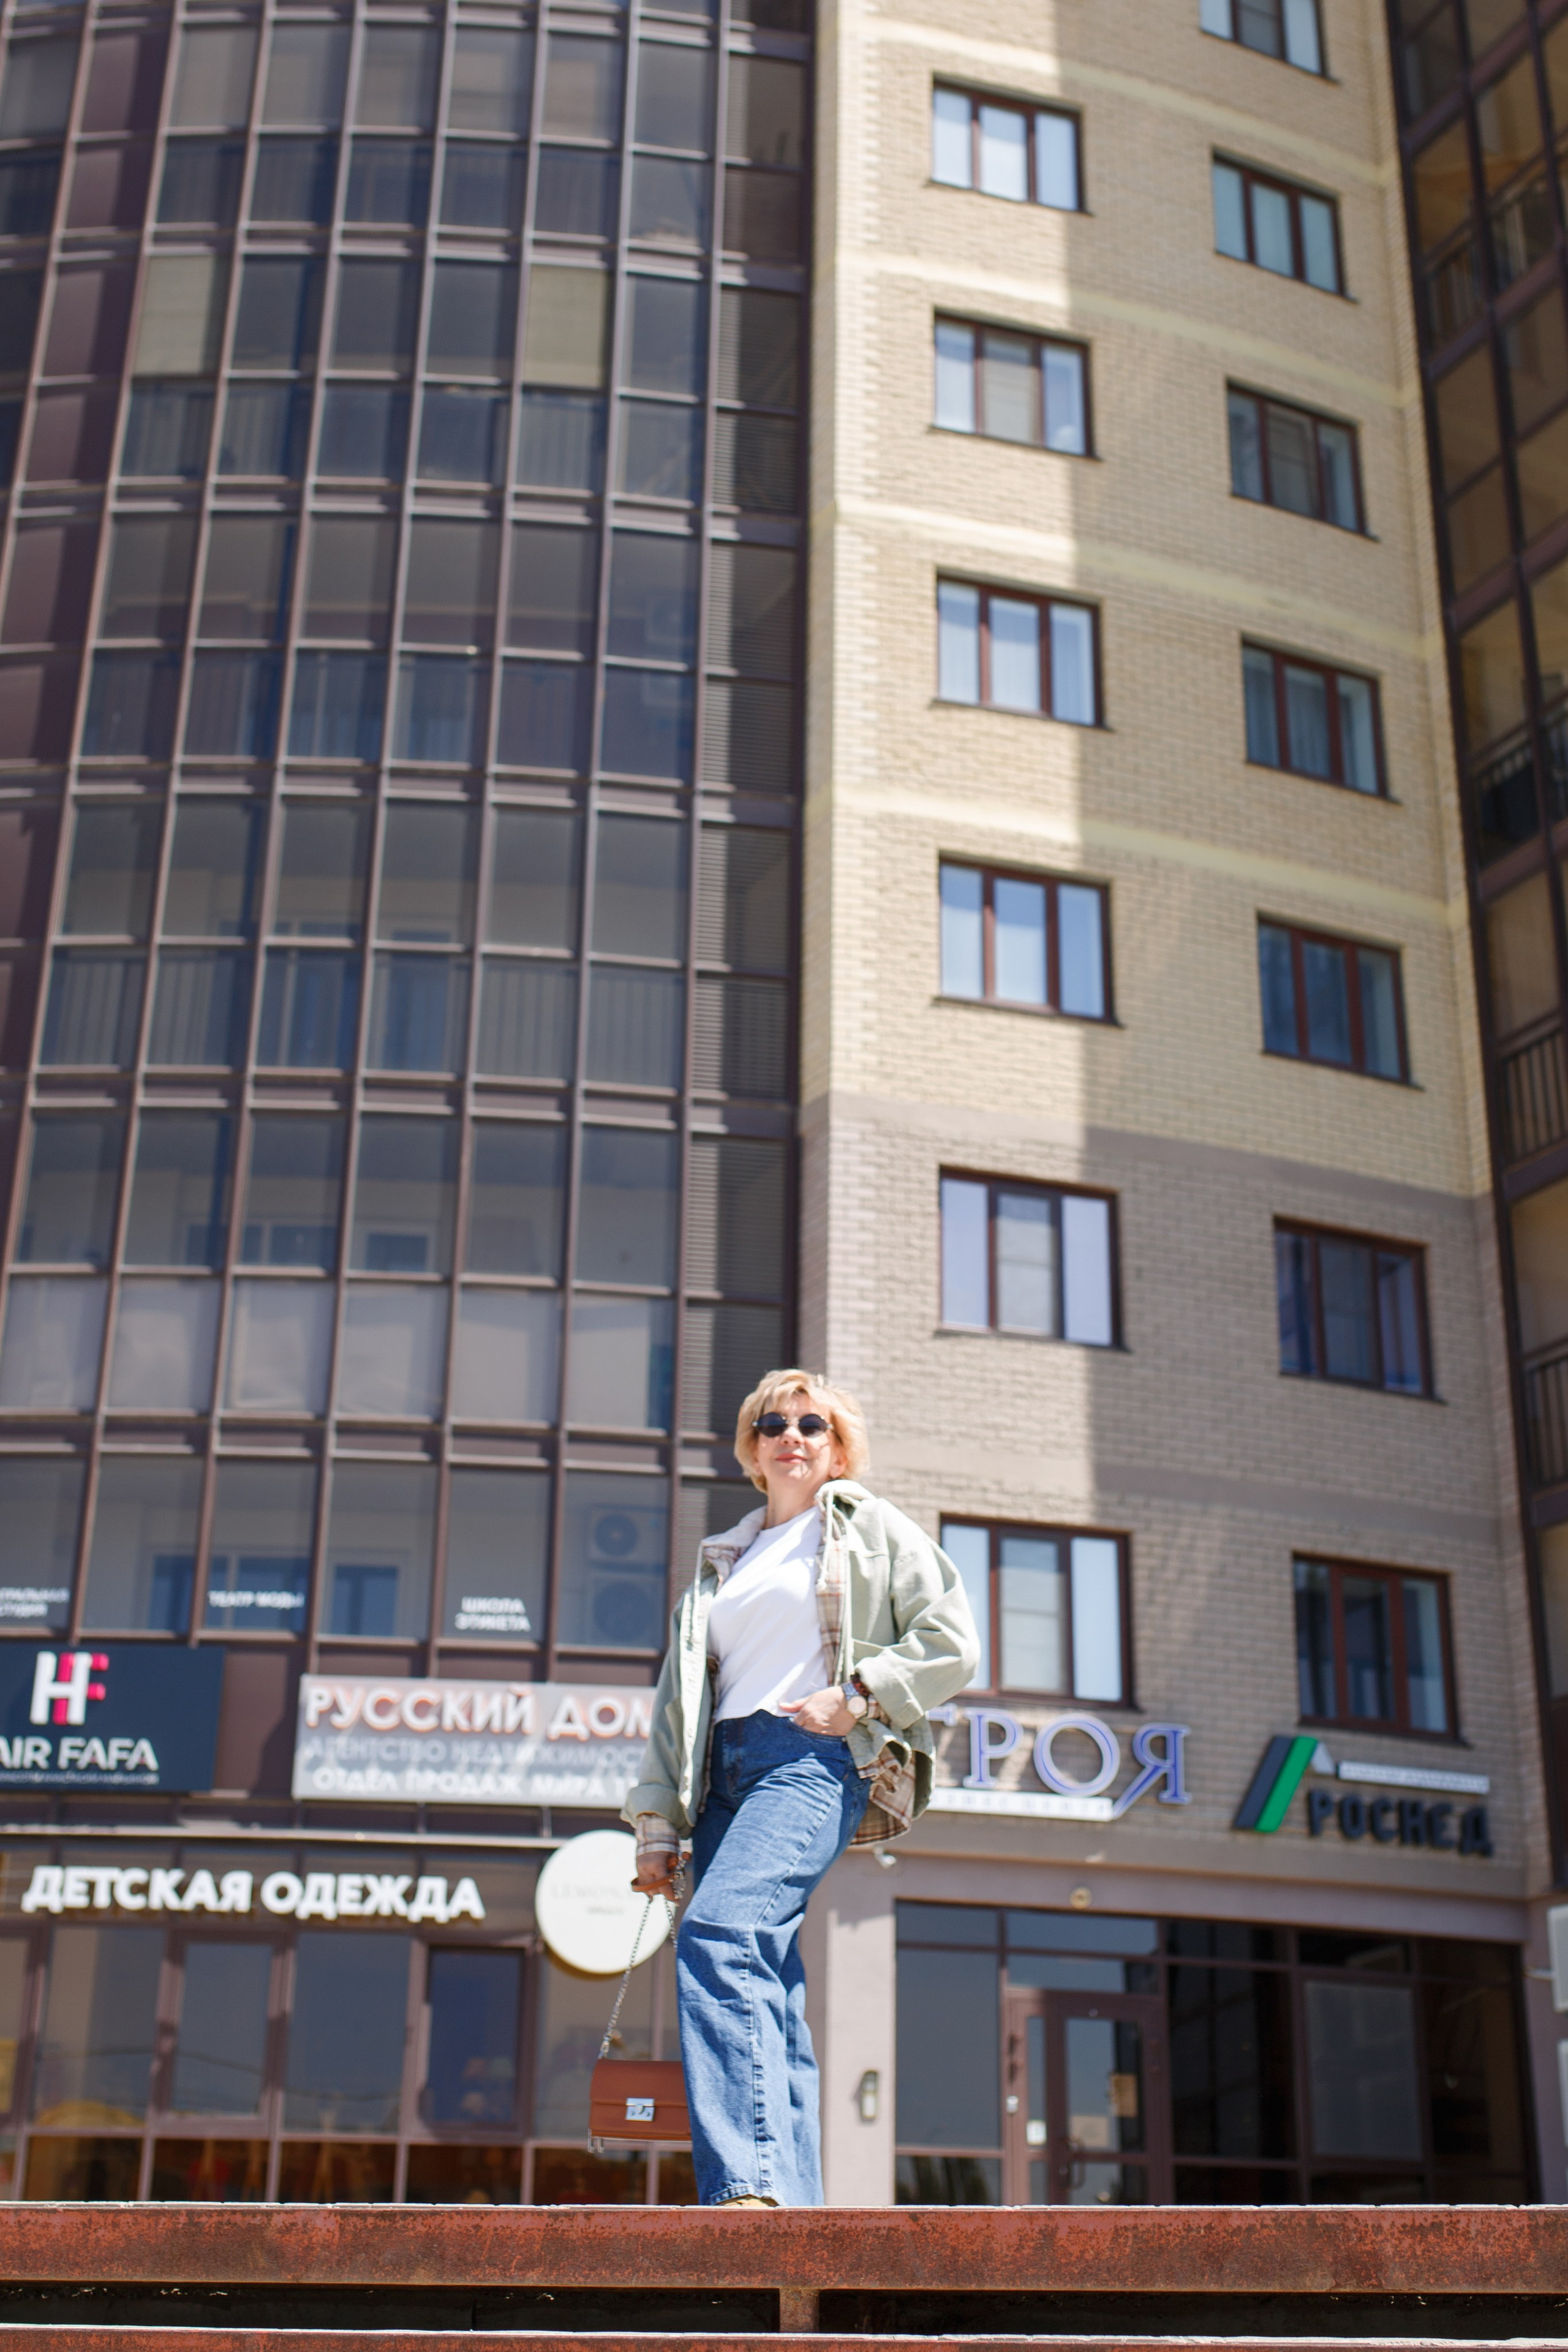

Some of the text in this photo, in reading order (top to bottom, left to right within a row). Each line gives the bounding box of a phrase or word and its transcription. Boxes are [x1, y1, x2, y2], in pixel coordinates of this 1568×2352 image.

[208, 1591, 255, 1608] ТЕАТР
[461, 1596, 526, 1614] ШКОЛА
[455, 1612, 531, 1632] ЭТИКЕТА
[306, 1683, 534, 1735] РУССКИЙ
[58, 1736, 159, 1771] FAFA
[305, 1735, 647, 1769] АГЕНТСТВО НЕДВИЖИМОС
[312, 1766, 398, 1793] ОТДЕЛ
[404, 1769, 522, 1798] ПРОДАЖ
[21, 1865, 486, 1923] ДЕТСКАЯ ОДЕЖДА
